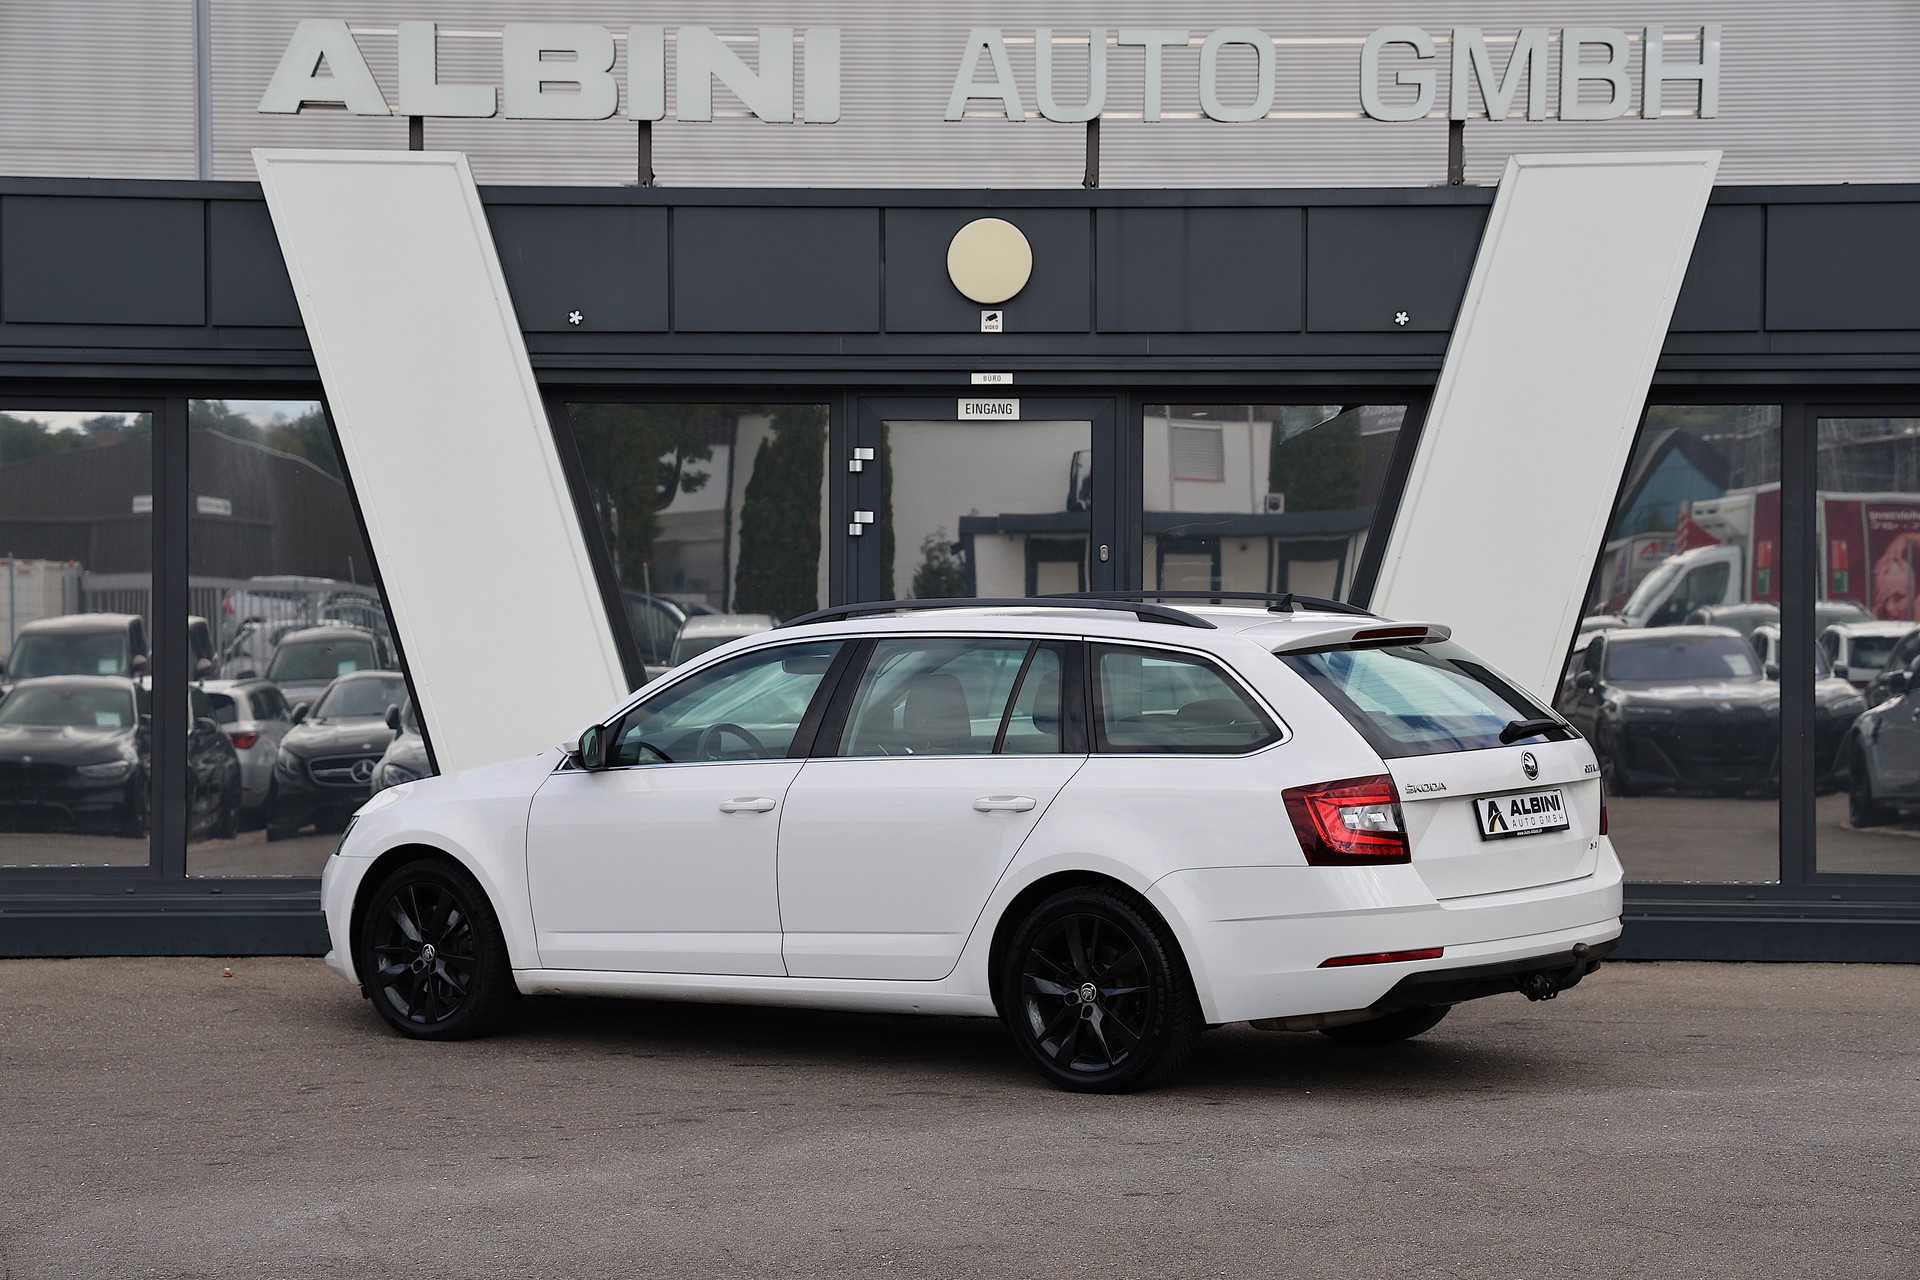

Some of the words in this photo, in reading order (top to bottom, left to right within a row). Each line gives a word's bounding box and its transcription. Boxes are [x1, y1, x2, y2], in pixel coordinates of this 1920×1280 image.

[257, 18, 841, 124] ALBINI
[944, 26, 1276, 123] AUTO
[1360, 24, 1723, 123] GMBH
[983, 373, 1002, 382] BÜRO
[965, 403, 1013, 415] EINGANG
[1510, 794, 1561, 817] ALBINI
[1512, 816, 1536, 829] AUTO
[1539, 813, 1564, 826] GMBH
